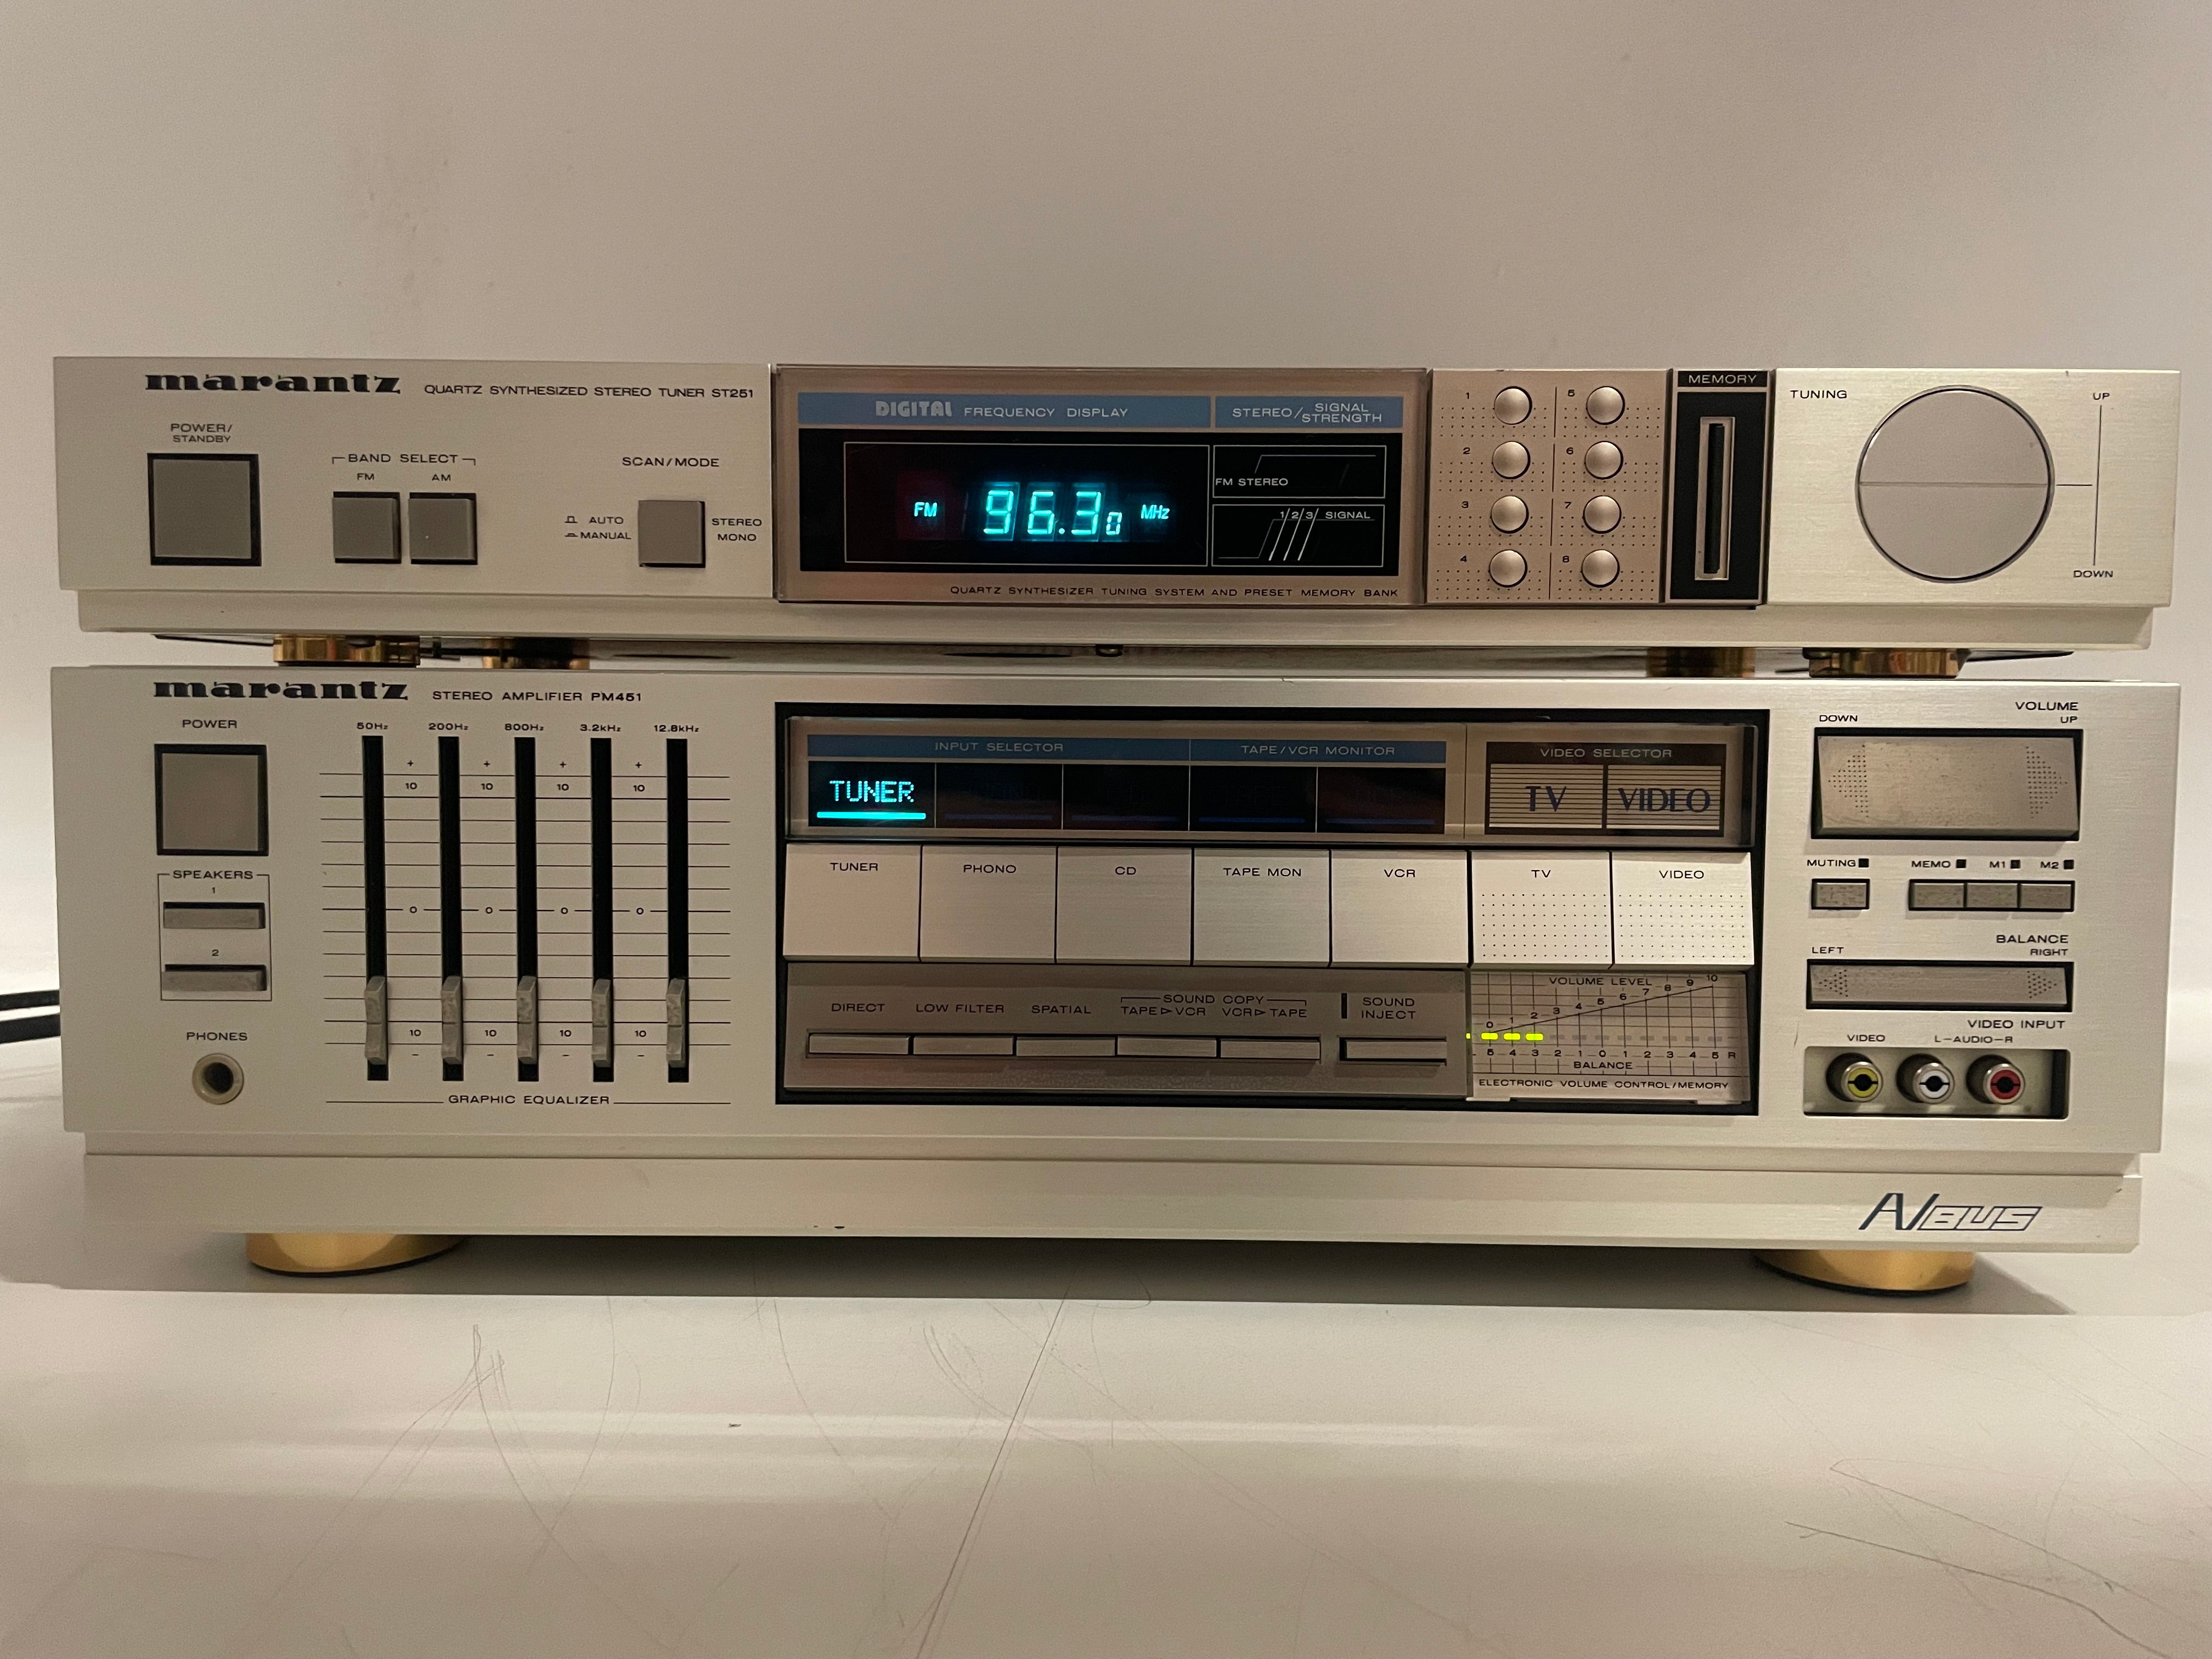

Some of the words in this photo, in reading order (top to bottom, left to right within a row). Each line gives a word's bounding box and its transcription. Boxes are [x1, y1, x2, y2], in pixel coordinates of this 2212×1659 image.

[1689, 374, 1757, 384] MEMORY
[145, 374, 401, 394] marantz
[425, 385, 482, 394] QUARTZ
[490, 386, 588, 396] SYNTHESIZED
[594, 387, 652, 397] STEREO
[658, 388, 704, 397] TUNER
[712, 389, 753, 398] ST251
[1790, 390, 1847, 399] TUNING
[876, 400, 952, 417] DIGITAL
[964, 407, 1054, 418] FREQUENCY
[1068, 408, 1128, 417] DISPLAY
[1314, 403, 1368, 412] SIGNAL
[1302, 413, 1382, 423] STRENGTH
[171, 424, 233, 432] POWER/
[173, 435, 231, 443] STANDBY
[348, 454, 391, 463] BAND
[400, 454, 458, 464] SELECT
[432, 473, 451, 482] AM
[1238, 478, 1288, 486] STEREO
[914, 502, 938, 517] FM
[1141, 505, 1170, 520] MHz
[580, 532, 631, 540] MANUAL
[718, 533, 757, 541] MONO
[950, 586, 1001, 595] QUARTZ
[1009, 586, 1093, 595] SYNTHESIZER
[1102, 587, 1147, 596] TUNING
[1155, 588, 1205, 596] SYSTEM
[154, 681, 408, 700] marantz
[432, 691, 493, 701] STEREO
[502, 692, 582, 701] AMPLIFIER
[591, 692, 641, 702] PM451
[2015, 702, 2078, 710] VOLUME
[182, 720, 237, 729] POWER
[357, 722, 388, 730] 50Hz
[654, 725, 699, 733] 12.8kHz
[935, 742, 978, 751] INPUT
[987, 743, 1063, 752] SELECTOR
[1326, 747, 1395, 755] MONITOR
[1540, 748, 1585, 758] VIDEO
[1593, 749, 1672, 758] SELECTOR
[830, 780, 915, 803] TUNER
[1526, 786, 1567, 812] TV
[1617, 788, 1711, 812] VIDEO
[830, 862, 878, 871] TUNER
[963, 865, 1016, 873] PHONO
[1115, 866, 1136, 874] CD
[173, 870, 253, 879] SPEAKERS
[1223, 868, 1260, 877] TAPE
[1268, 868, 1301, 877] MON
[1384, 869, 1415, 878] VCR
[1531, 870, 1551, 878] TV
[1659, 870, 1704, 879] VIDEO
[1996, 935, 2069, 944] BALANCE
[1611, 978, 1652, 986] LEVEL
[1164, 995, 1215, 1003] SOUND
[1223, 995, 1264, 1005] COPY
[1362, 997, 1415, 1007] SOUND
[832, 1003, 885, 1012] DIRECT
[916, 1004, 949, 1012] LOW
[956, 1005, 1004, 1013] FILTER
[1031, 1005, 1091, 1014] SPATIAL
[1121, 1007, 1157, 1015] TAPE
[1175, 1007, 1206, 1015] VCR
[1222, 1008, 1252, 1017] VCR
[1270, 1008, 1307, 1018] TAPE
[1361, 1010, 1417, 1019] INJECT
[1967, 1020, 2013, 1029] VIDEO
[2021, 1020, 2066, 1029] INPUT
[187, 1032, 247, 1041] PHONES
[1479, 1079, 1553, 1087] ELECTRONIC
[449, 1095, 515, 1104] GRAPHIC
[524, 1096, 609, 1105] EQUALIZER
